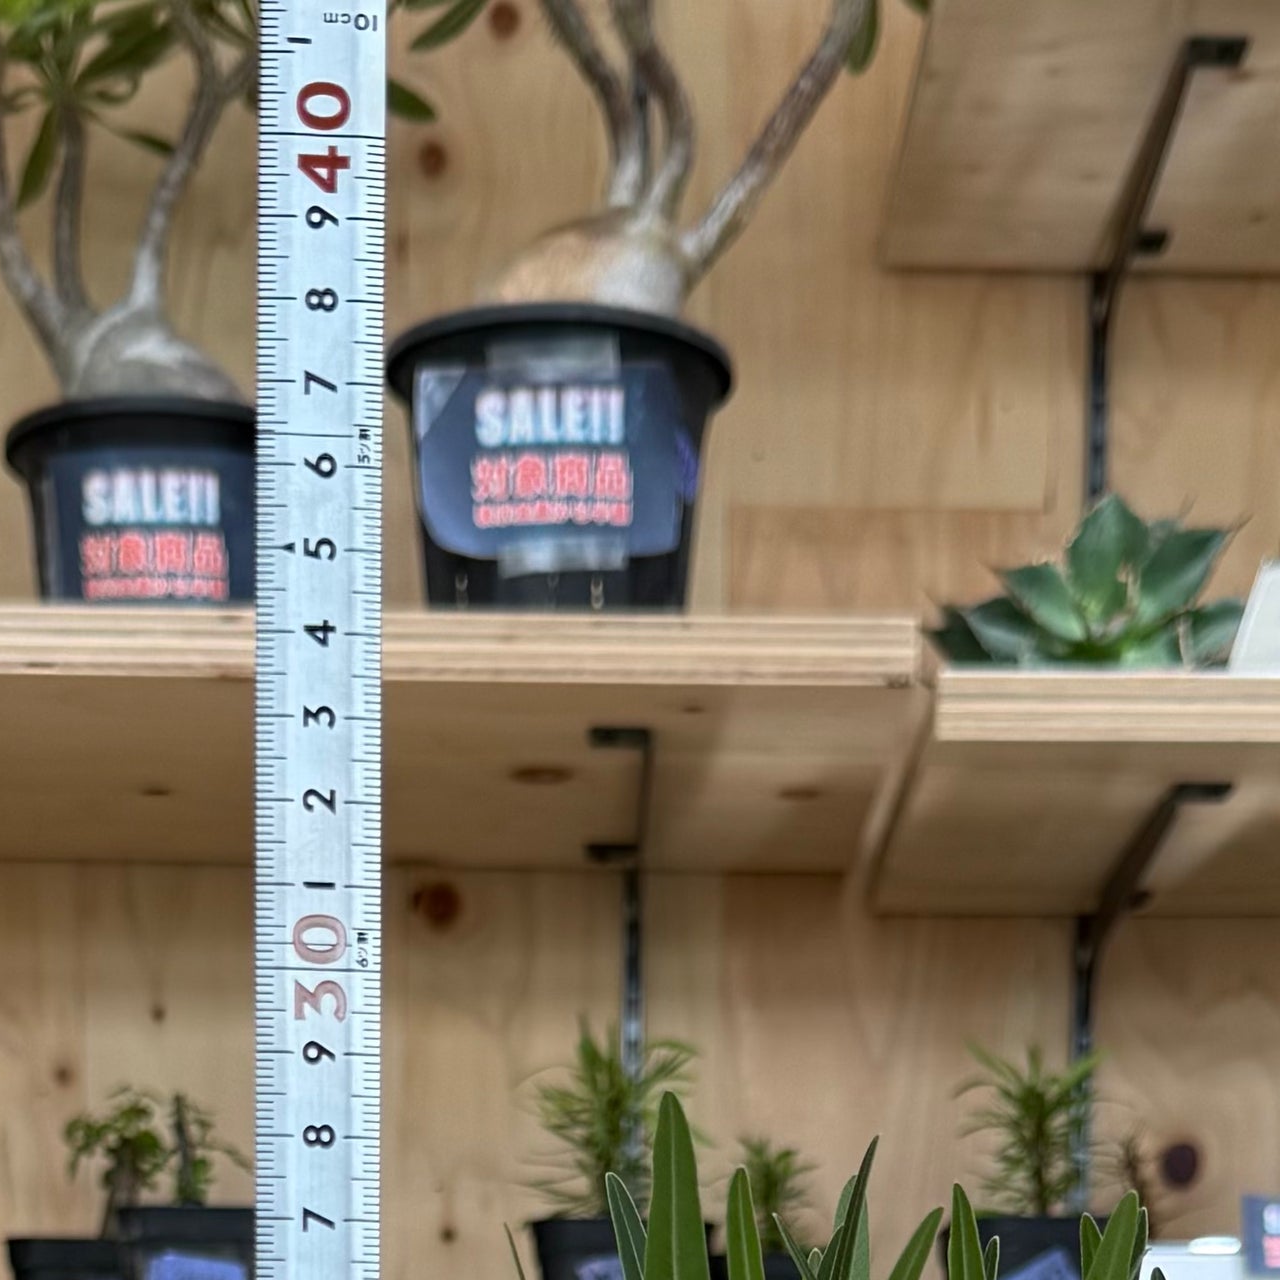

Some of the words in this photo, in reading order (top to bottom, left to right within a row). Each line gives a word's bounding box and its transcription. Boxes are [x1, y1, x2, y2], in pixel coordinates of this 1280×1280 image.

[287, 37, 312, 45] 1
[297, 82, 351, 194] 40
[306, 206, 339, 229] 9
[305, 288, 338, 312] 8
[304, 370, 337, 394] 7
[304, 453, 337, 478] 6
[304, 538, 336, 560] 5
[304, 620, 336, 647] 4
[303, 706, 335, 728] 3
[303, 789, 335, 813] 2
[303, 881, 335, 890] 1
[292, 914, 348, 1023] 30
[303, 1041, 335, 1064] 9
[303, 1125, 335, 1148] 8
[303, 1207, 335, 1232] 7
